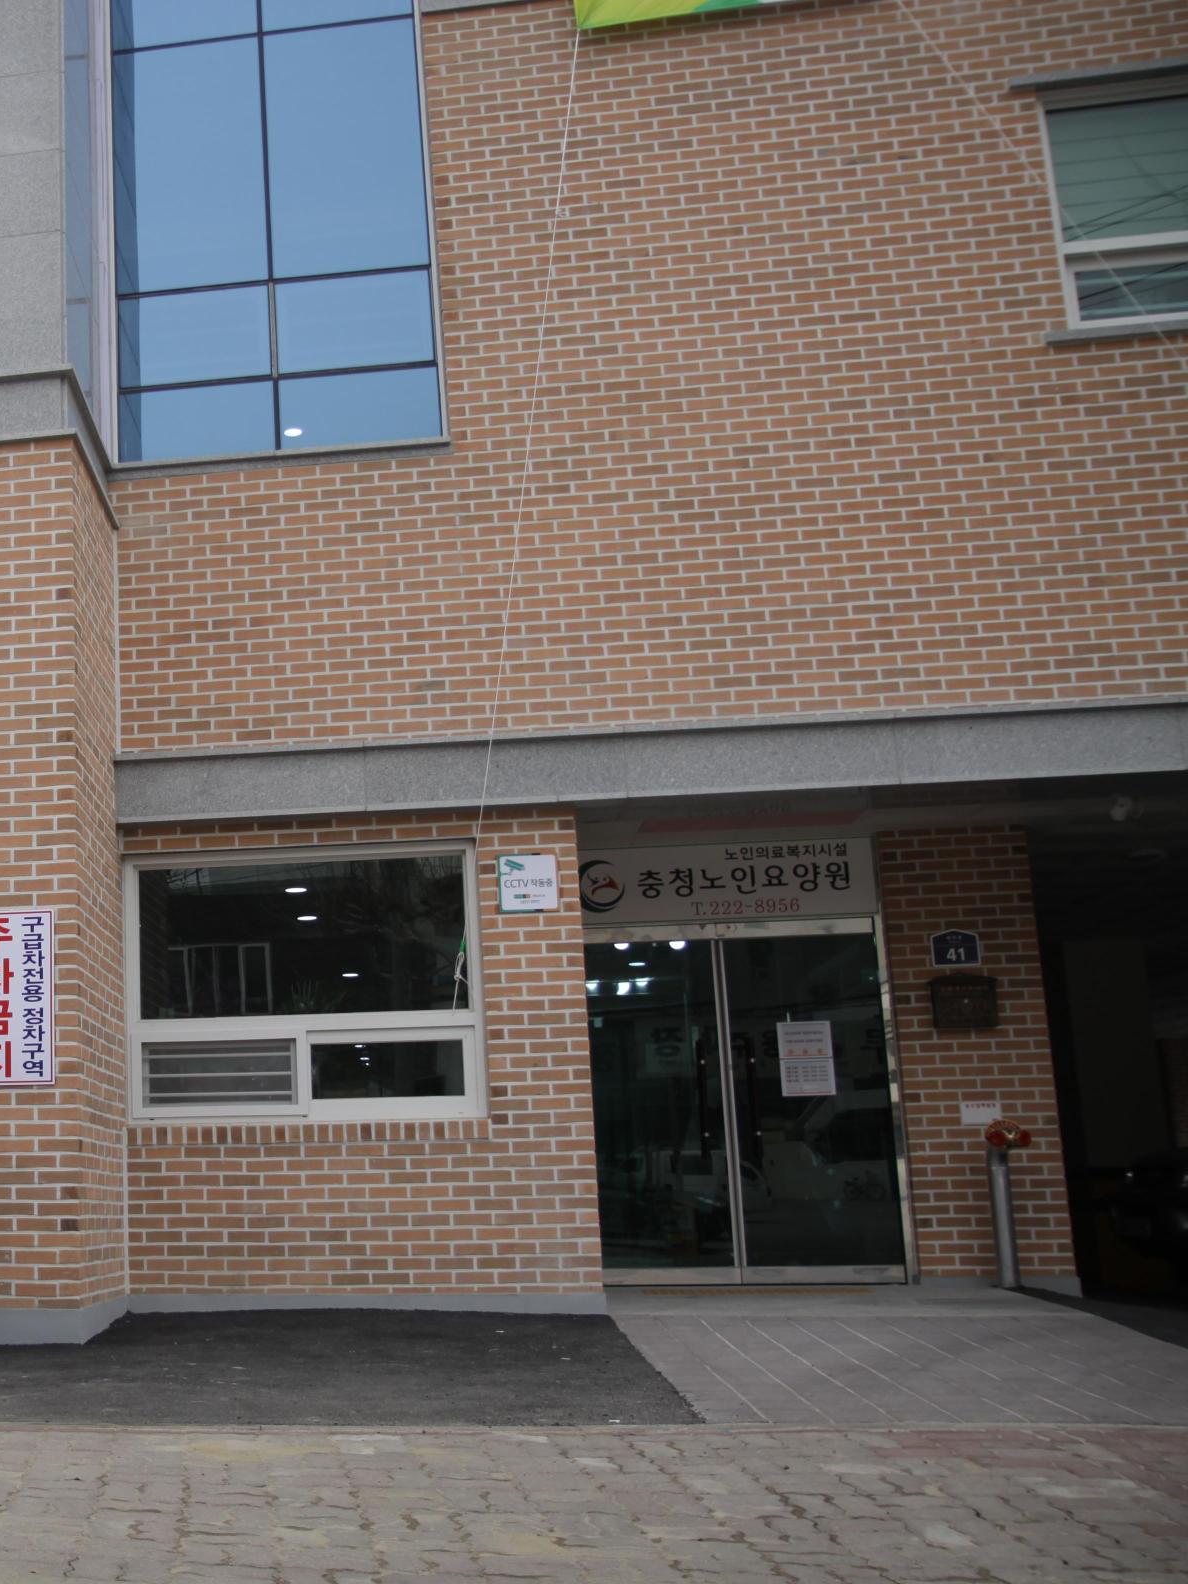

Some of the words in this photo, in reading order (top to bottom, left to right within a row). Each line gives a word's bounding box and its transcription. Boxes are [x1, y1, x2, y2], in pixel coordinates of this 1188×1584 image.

[724, 842, 848, 861] 노인의료복지시설
[504, 879, 529, 889] CCTV
[531, 878, 554, 889] 작동중
[637, 861, 851, 899] 충청노인요양원
[691, 899, 800, 916] T.222-8956
[21, 916, 45, 1003] 구급차전용
[946, 947, 966, 962] 41
[21, 1007, 45, 1077] 정차구역
